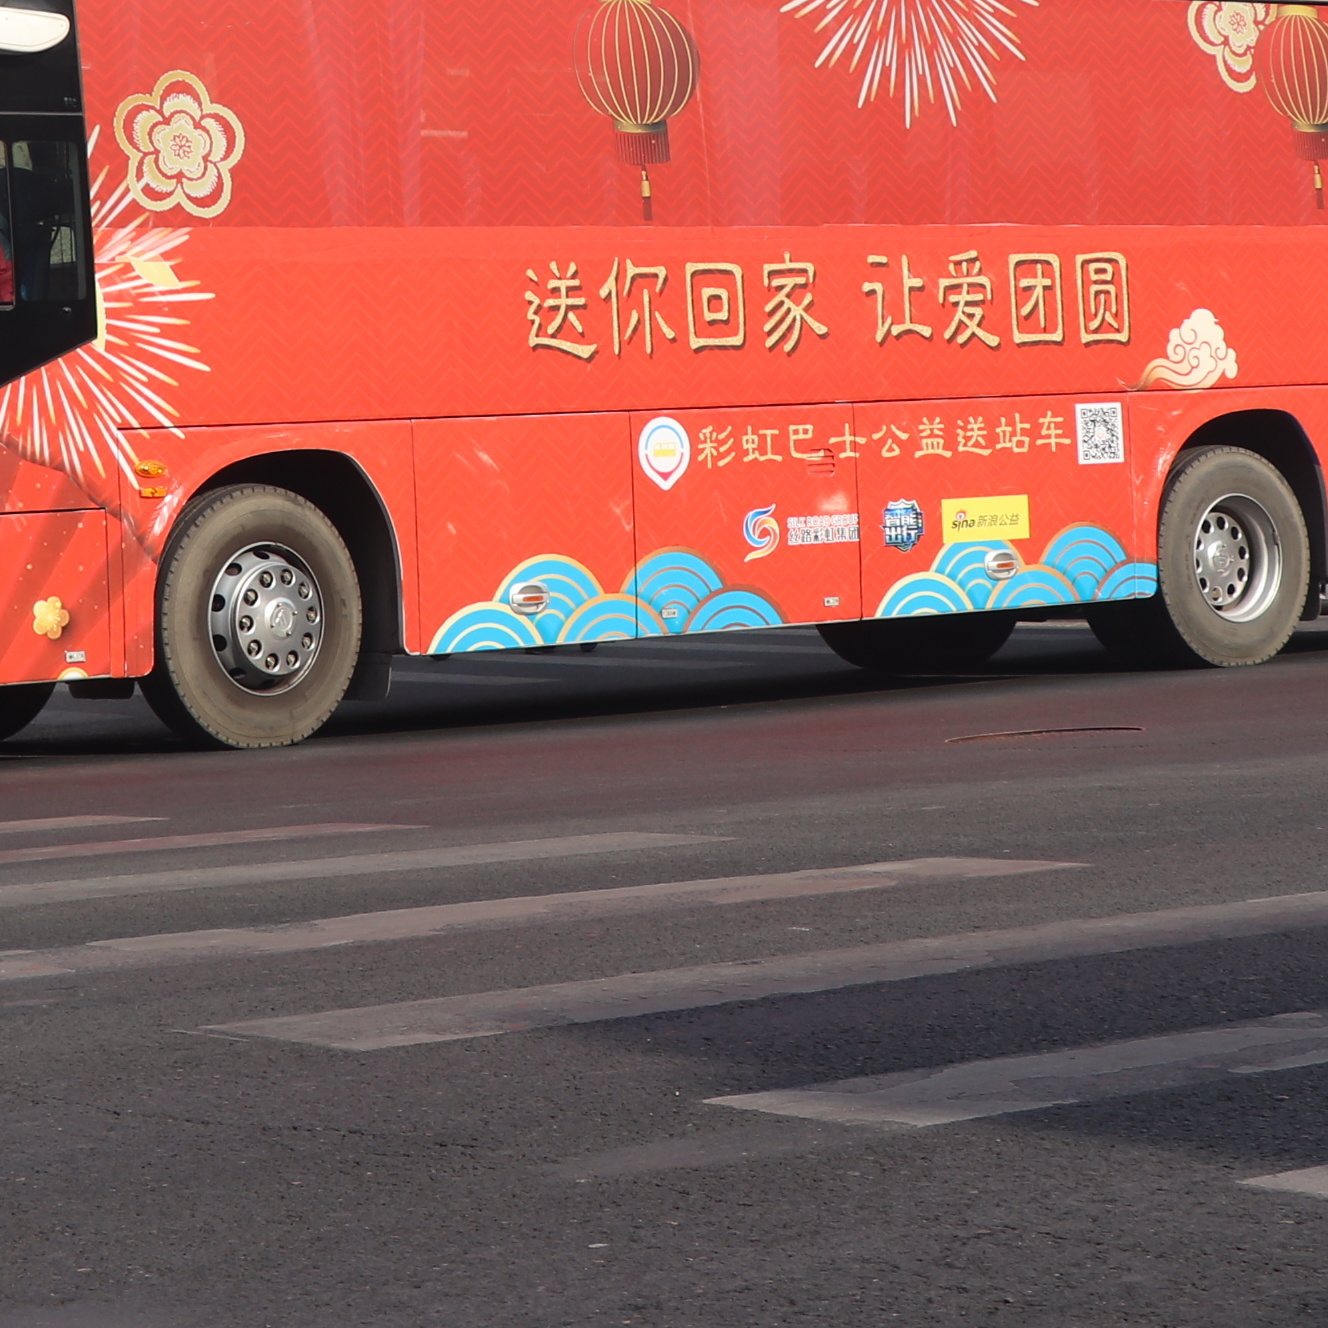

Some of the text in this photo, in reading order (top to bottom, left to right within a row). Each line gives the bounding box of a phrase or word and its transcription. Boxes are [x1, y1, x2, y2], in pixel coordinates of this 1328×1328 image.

[525, 250, 1130, 359] 送你回家 让爱团圆
[697, 413, 1073, 470] 彩虹巴士公益送站车
[789, 526, 859, 543] 丝路彩虹集团
[951, 512, 1019, 532] sina 新浪公益
